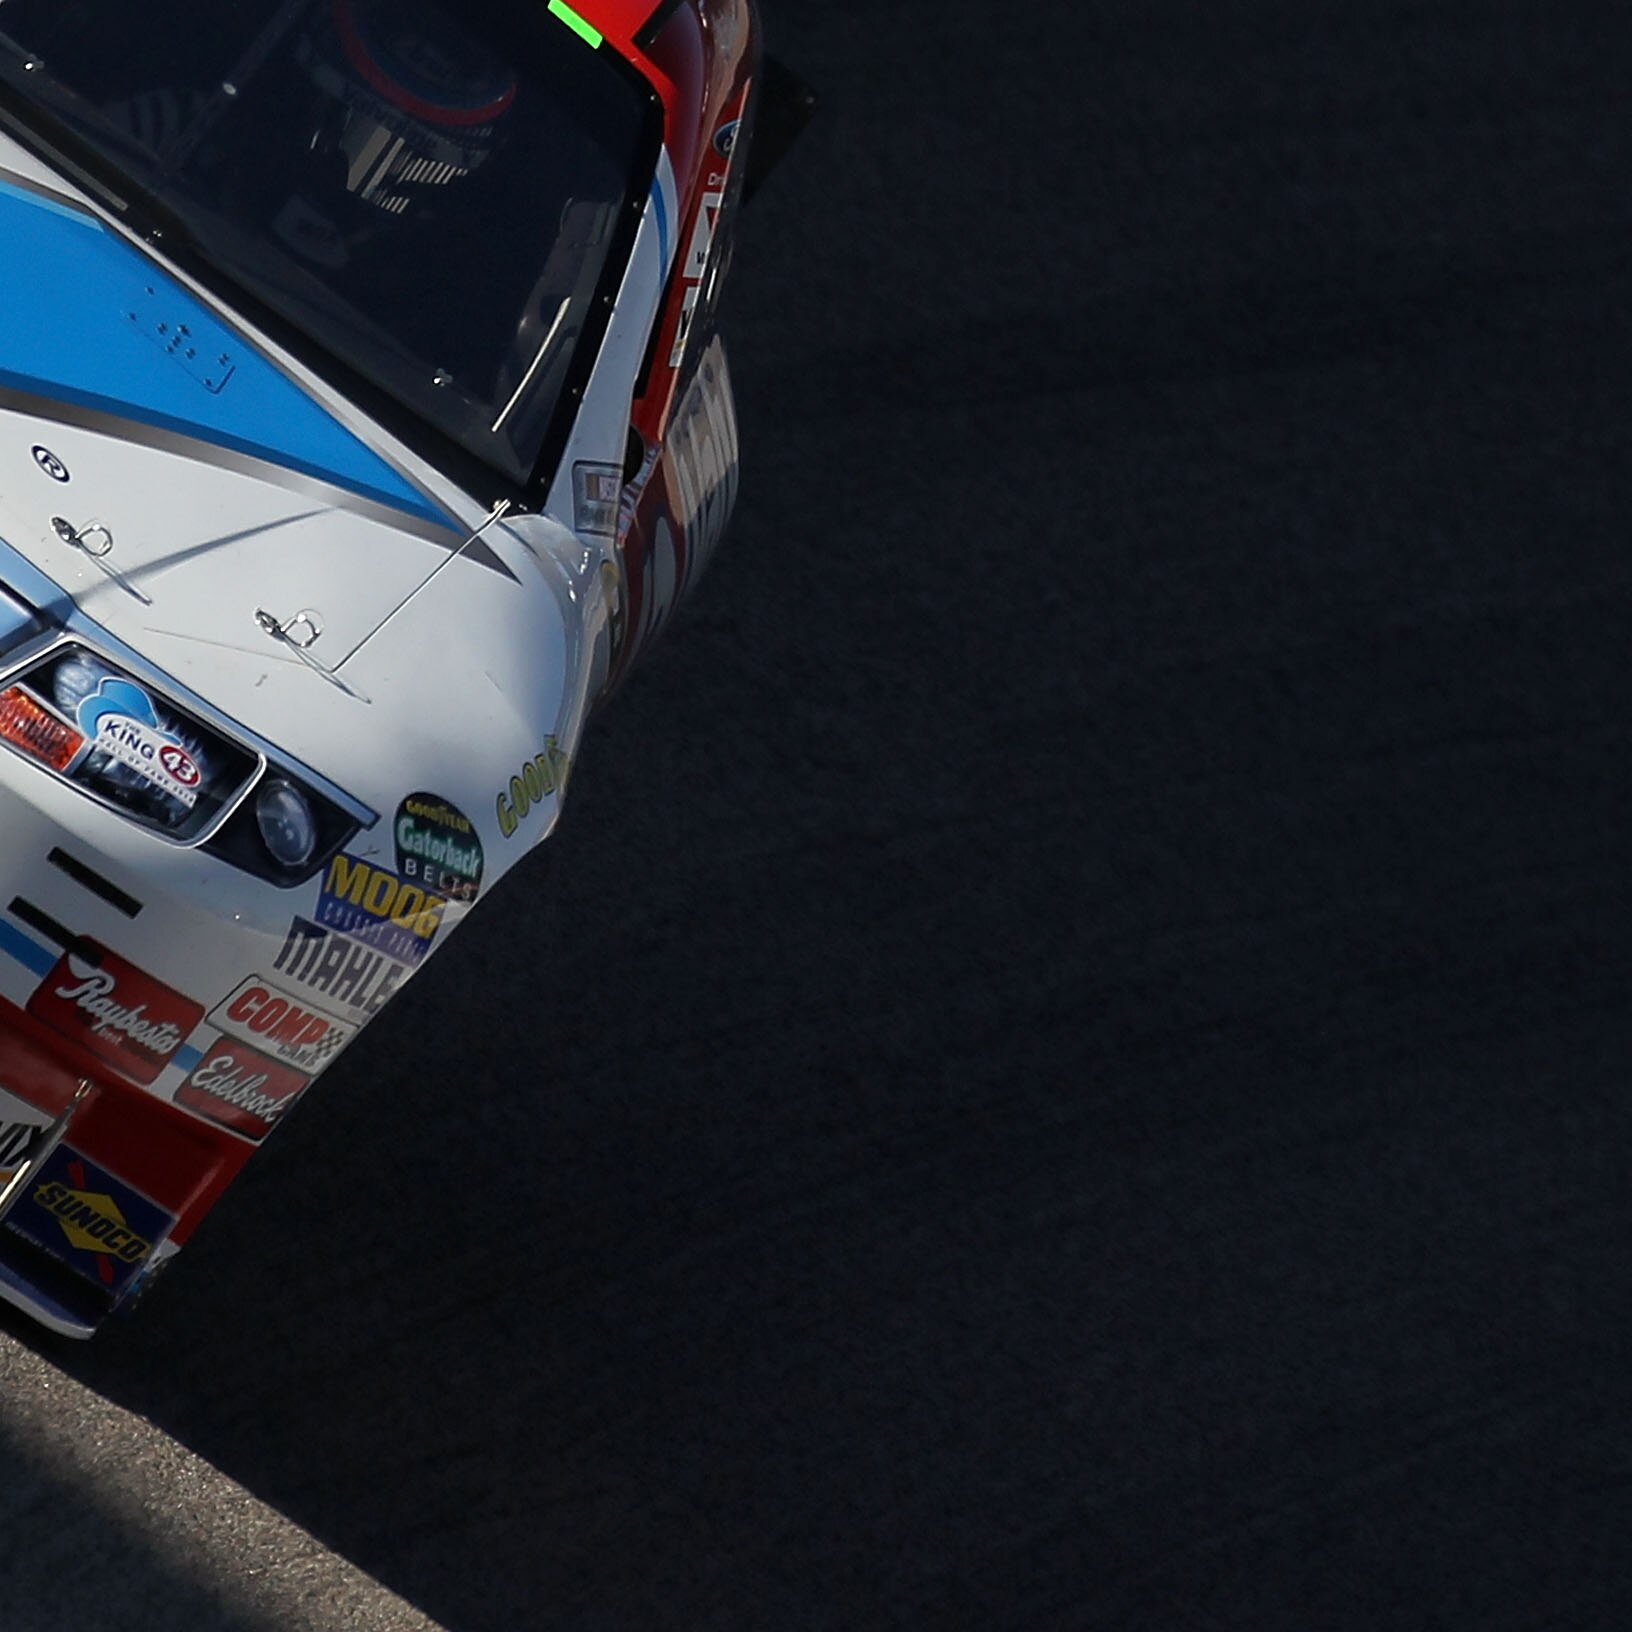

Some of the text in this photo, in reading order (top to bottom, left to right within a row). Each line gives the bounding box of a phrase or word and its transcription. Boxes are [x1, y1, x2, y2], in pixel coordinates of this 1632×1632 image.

[104, 719, 155, 760] KING
[163, 751, 197, 782] 43
[397, 816, 481, 878] Gatorback
[405, 858, 473, 900] BELTS
[324, 855, 446, 939] MOOG
[273, 915, 404, 1014] MAHLE
[54, 953, 180, 1054] Raybestos
[227, 987, 330, 1046] COMP
[191, 1055, 296, 1124] Edelbrock
[37, 1183, 147, 1260] SUNOCO
